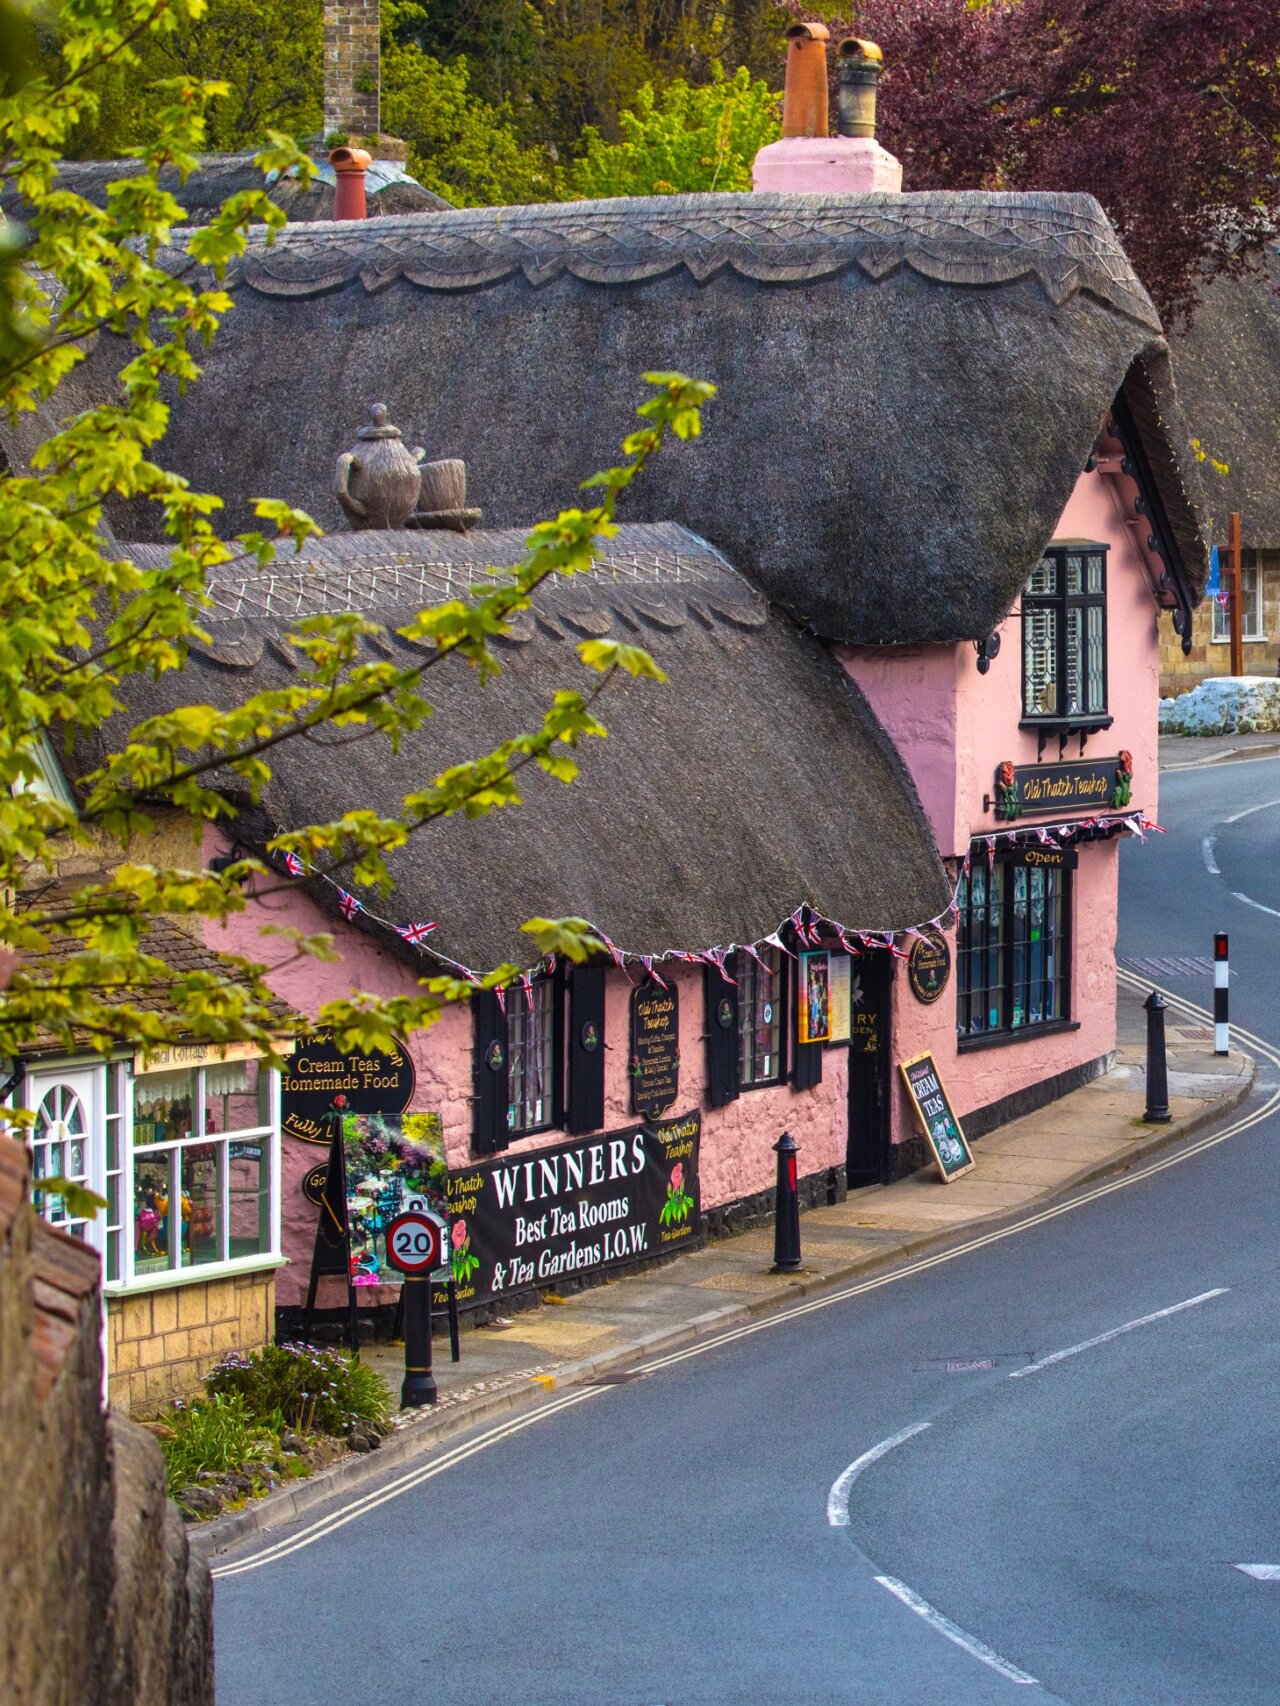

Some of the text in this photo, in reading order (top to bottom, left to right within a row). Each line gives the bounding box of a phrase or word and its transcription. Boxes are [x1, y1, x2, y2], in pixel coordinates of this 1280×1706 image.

[1024, 773, 1108, 800] Old Thatch Teashop
[1025, 850, 1063, 866] Open
[298, 1058, 345, 1073] Cream
[349, 1057, 380, 1072] Teas
[281, 1073, 399, 1091] Homemade Food
[912, 1073, 939, 1100] CREAM
[923, 1094, 944, 1117] TEAS
[286, 1113, 322, 1138] Fully
[657, 1119, 698, 1144] Old Thatch
[665, 1140, 693, 1160] Teashop
[455, 1172, 484, 1193] Thatch
[491, 1134, 646, 1209] WINNERS
[449, 1195, 477, 1215] eashop
[515, 1196, 629, 1247] Best Tea Rooms
[397, 1232, 431, 1253] 20
[661, 1225, 693, 1243] Tea Garden
[491, 1222, 648, 1292] & Tea Gardens I.O.W.
